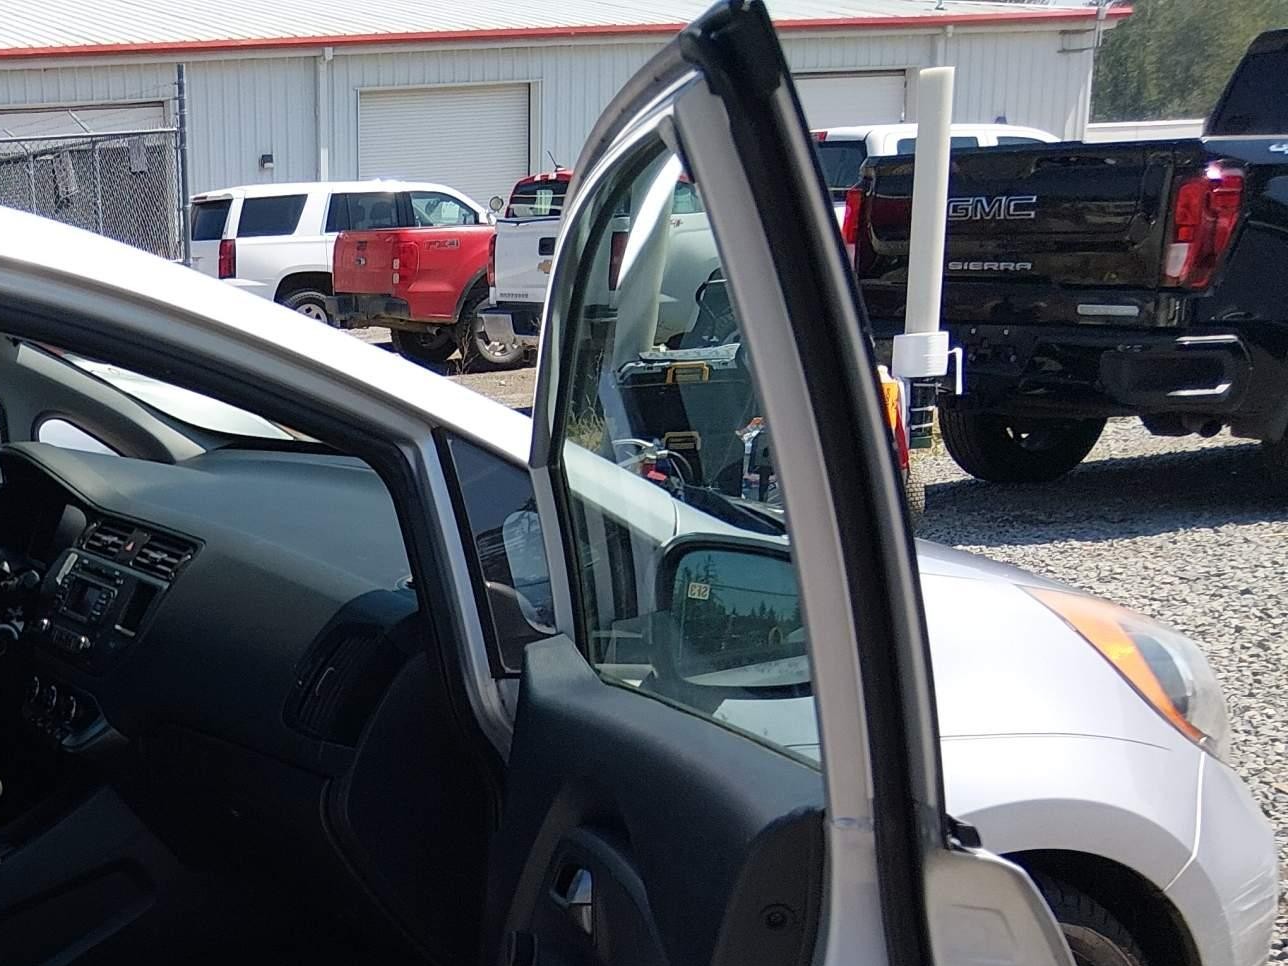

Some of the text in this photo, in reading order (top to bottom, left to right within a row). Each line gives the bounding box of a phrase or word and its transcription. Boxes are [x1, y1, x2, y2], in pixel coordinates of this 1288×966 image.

[947, 196, 1037, 220] GMC
[424, 239, 461, 249] FX4
[947, 261, 1033, 271] SIERRA
